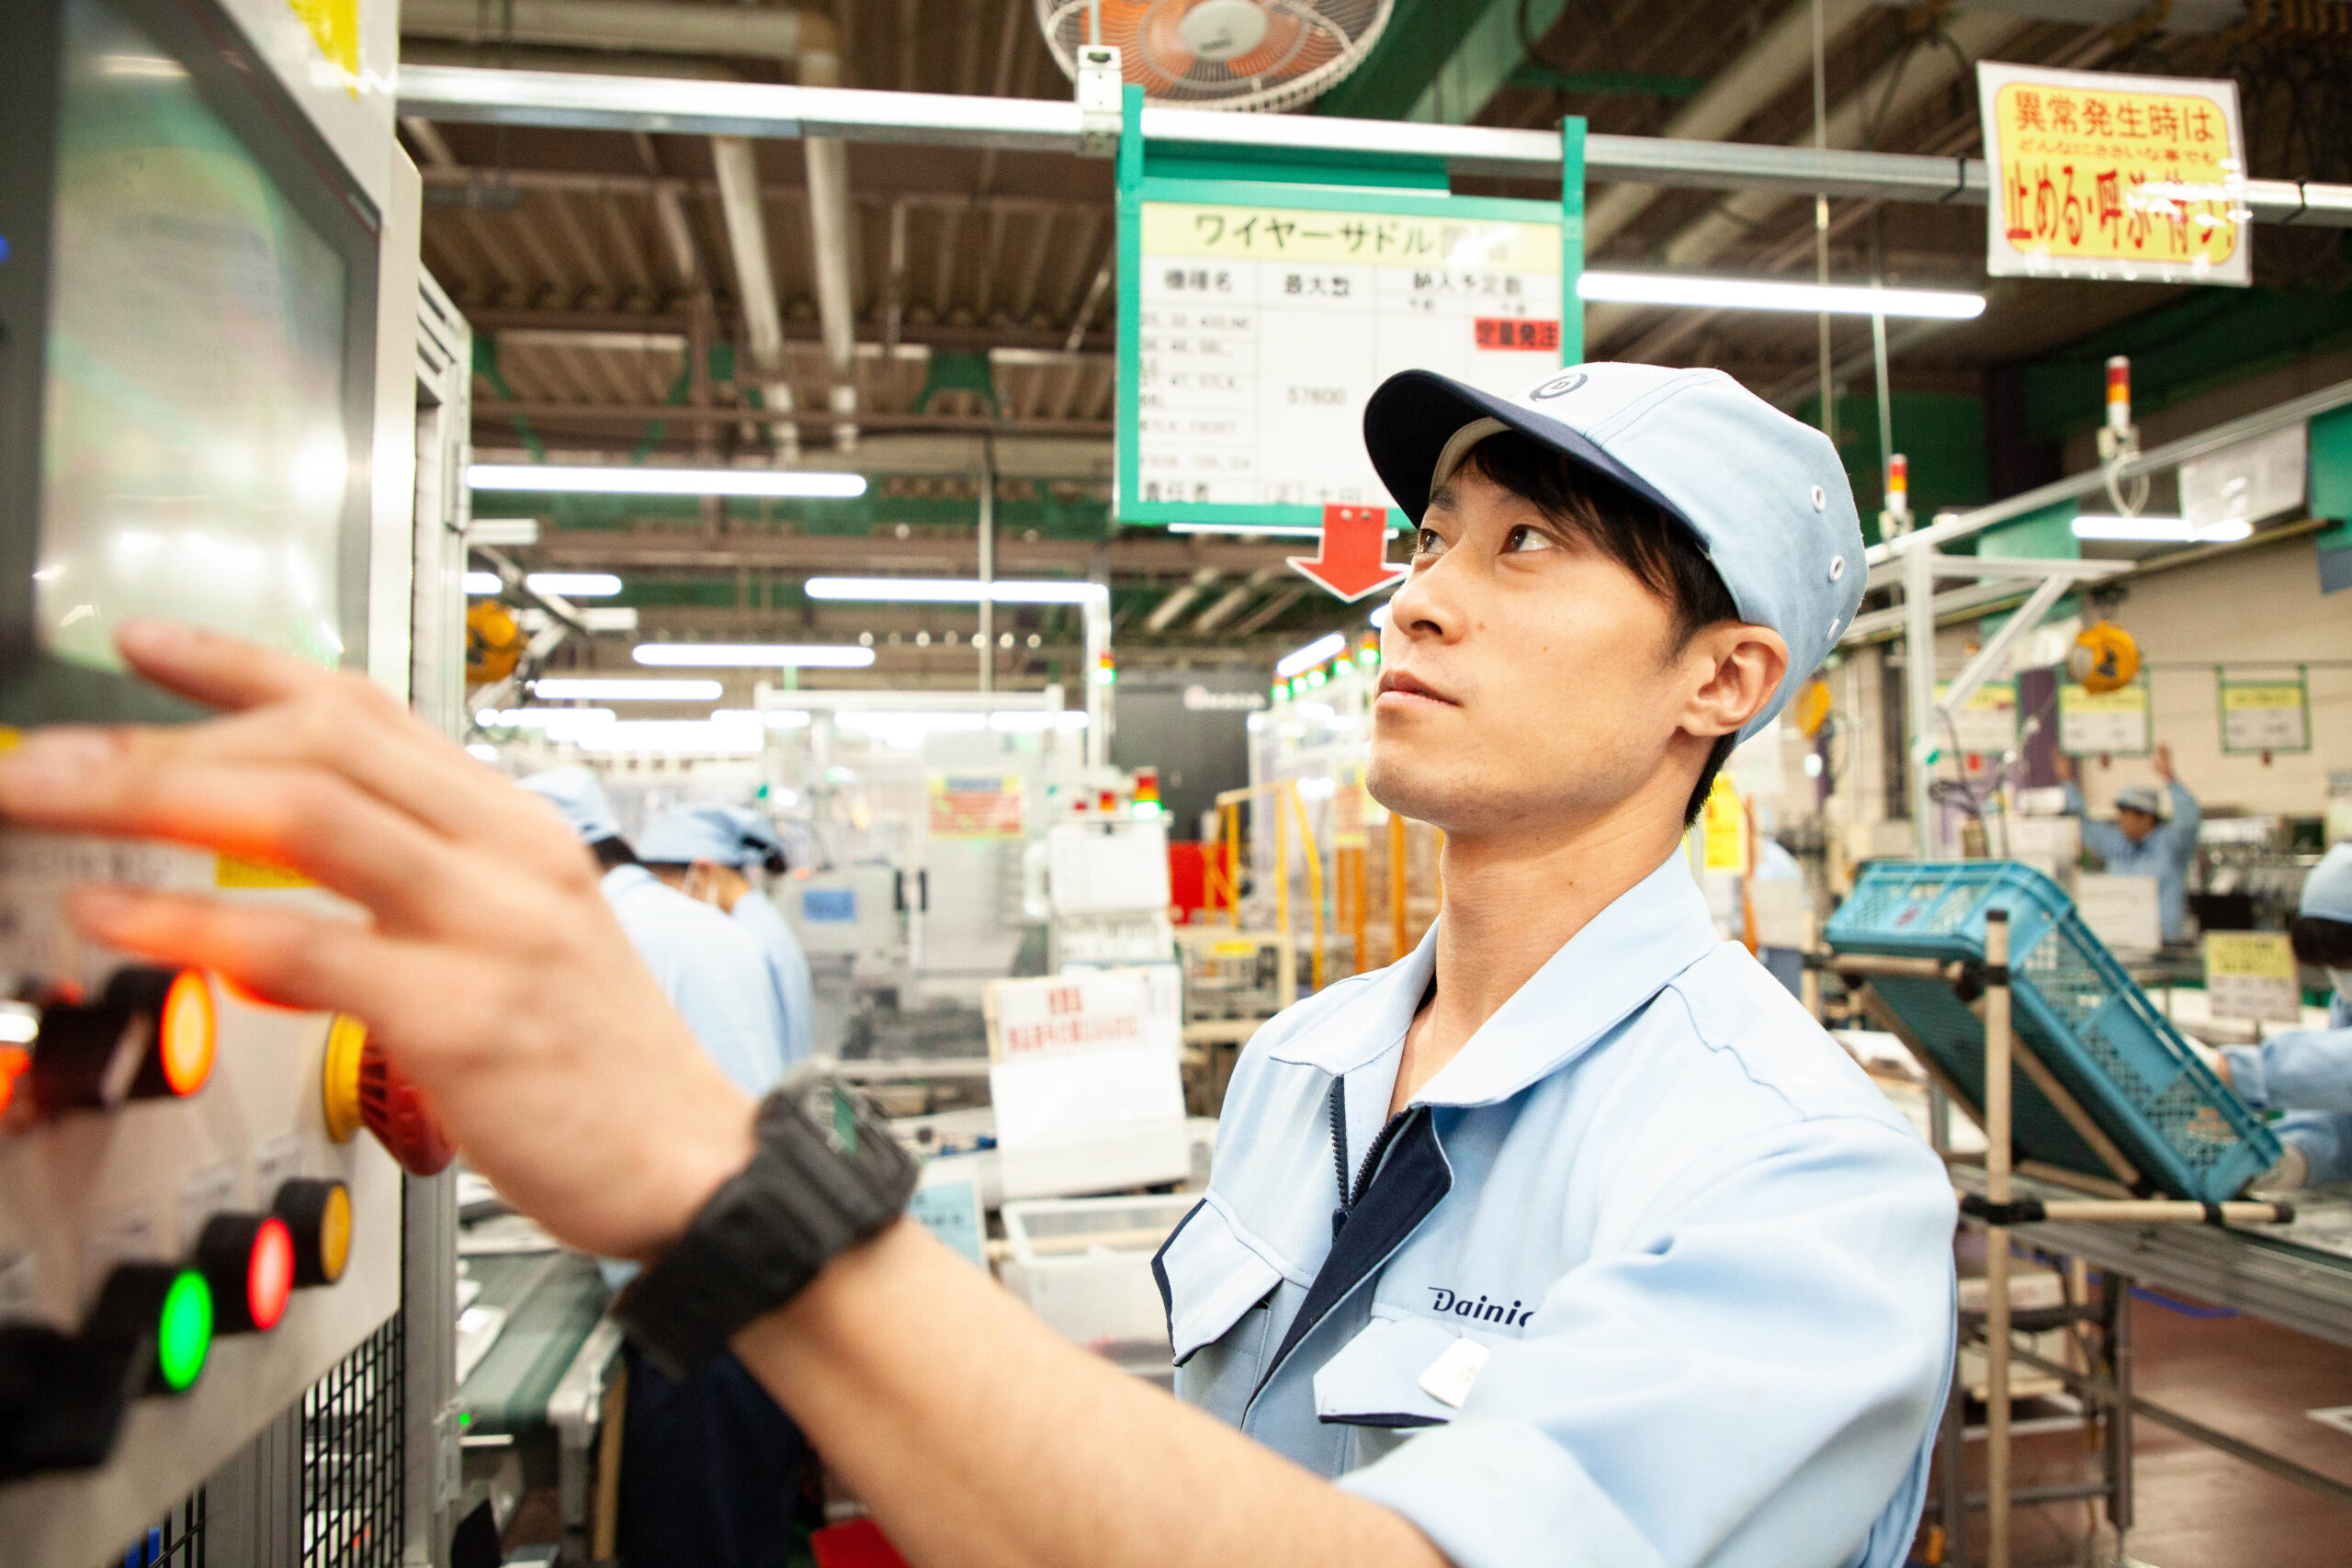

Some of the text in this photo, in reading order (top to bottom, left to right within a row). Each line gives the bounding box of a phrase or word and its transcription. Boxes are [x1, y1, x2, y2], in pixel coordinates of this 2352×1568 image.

[2015, 90, 2214, 142] 異常発生時は
[1195, 214, 1510, 261] ワイヤーサドル
[1284, 274, 1351, 296] 最大数
[1476, 321, 1558, 347] 定量発注
